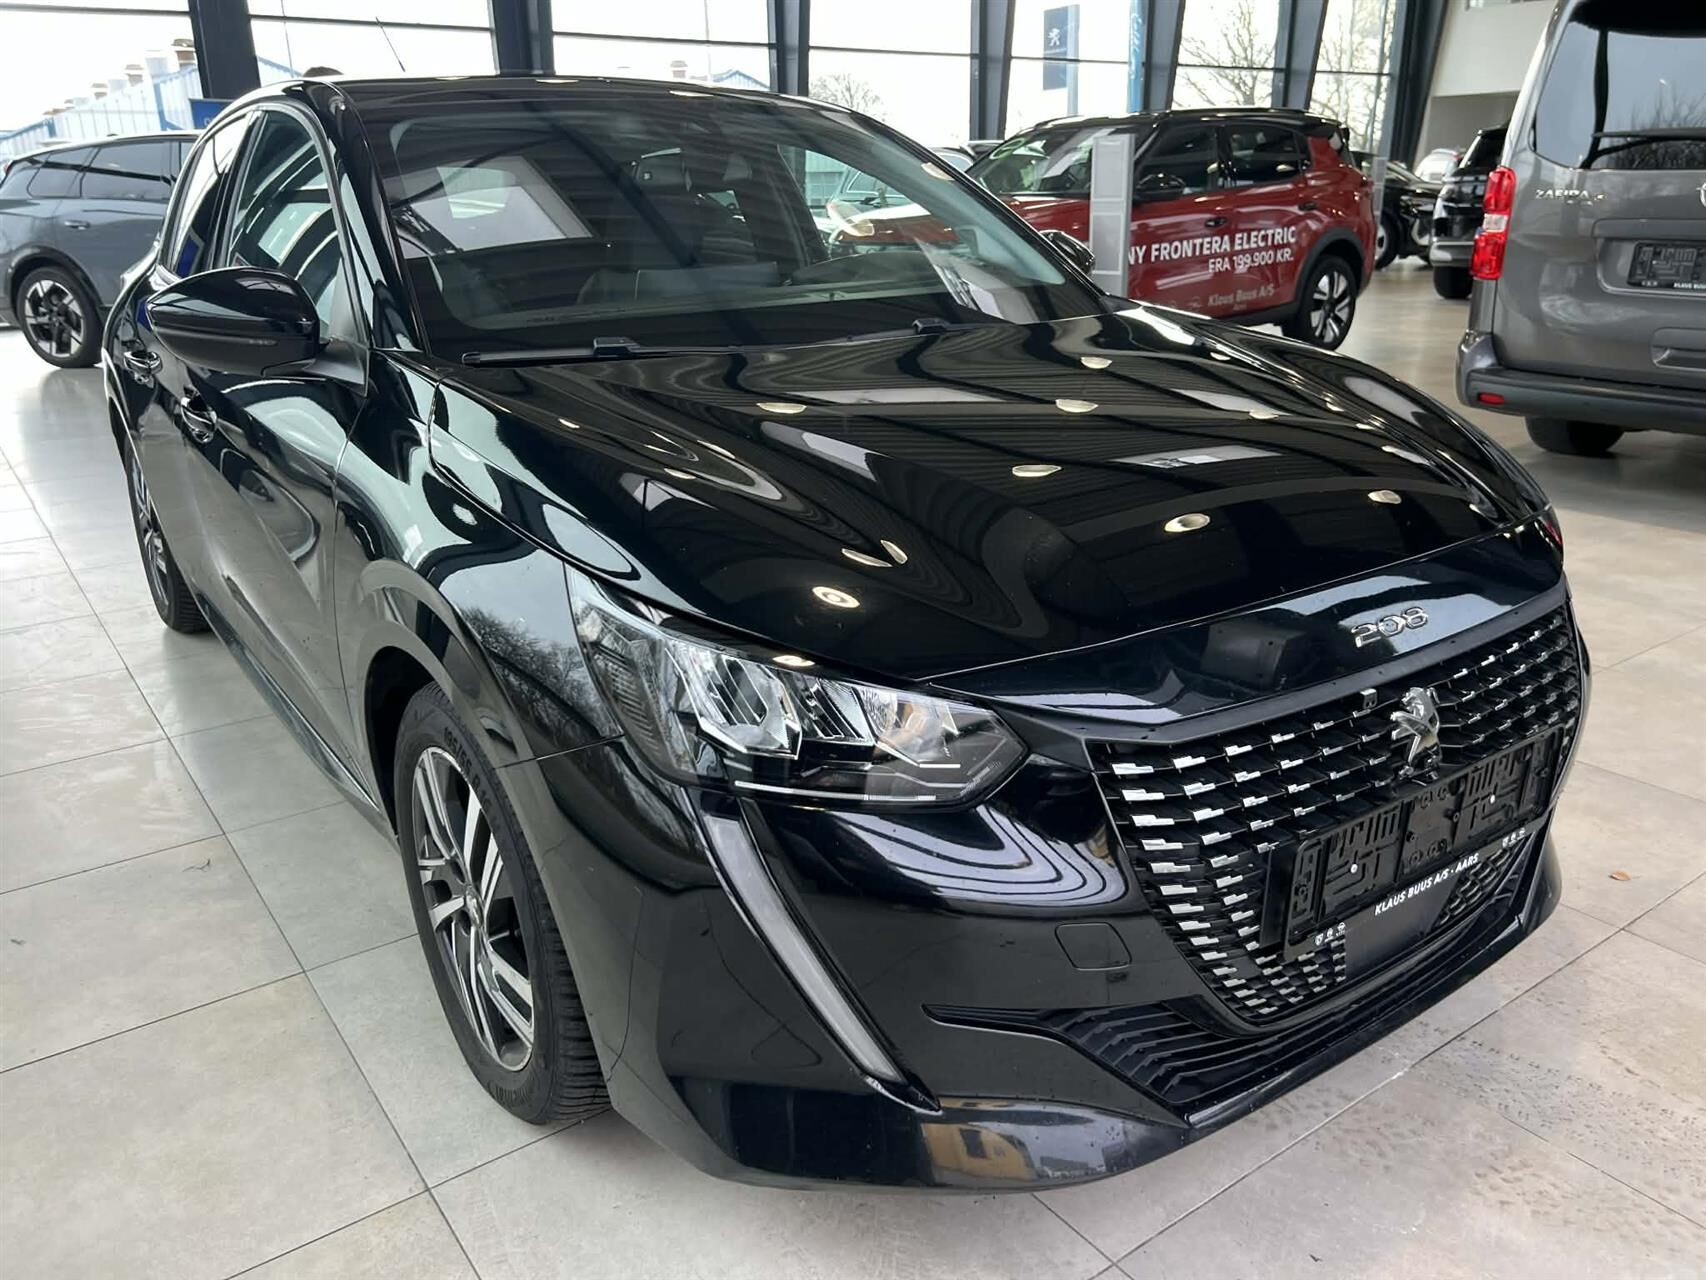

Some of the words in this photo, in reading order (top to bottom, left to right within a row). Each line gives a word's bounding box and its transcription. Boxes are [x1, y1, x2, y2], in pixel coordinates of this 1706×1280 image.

[1151, 235, 1230, 263] FRONTERA
[1235, 226, 1297, 250] ELECTRIC
[1208, 256, 1231, 273] FRA
[1232, 247, 1274, 268] 199.900
[1275, 247, 1294, 263] KR.
[1350, 607, 1429, 648] 208
[1374, 889, 1406, 916] KLAUS
[1407, 876, 1433, 899] BUUS
[1433, 868, 1450, 885] A/S
[1455, 852, 1480, 873] AARS
